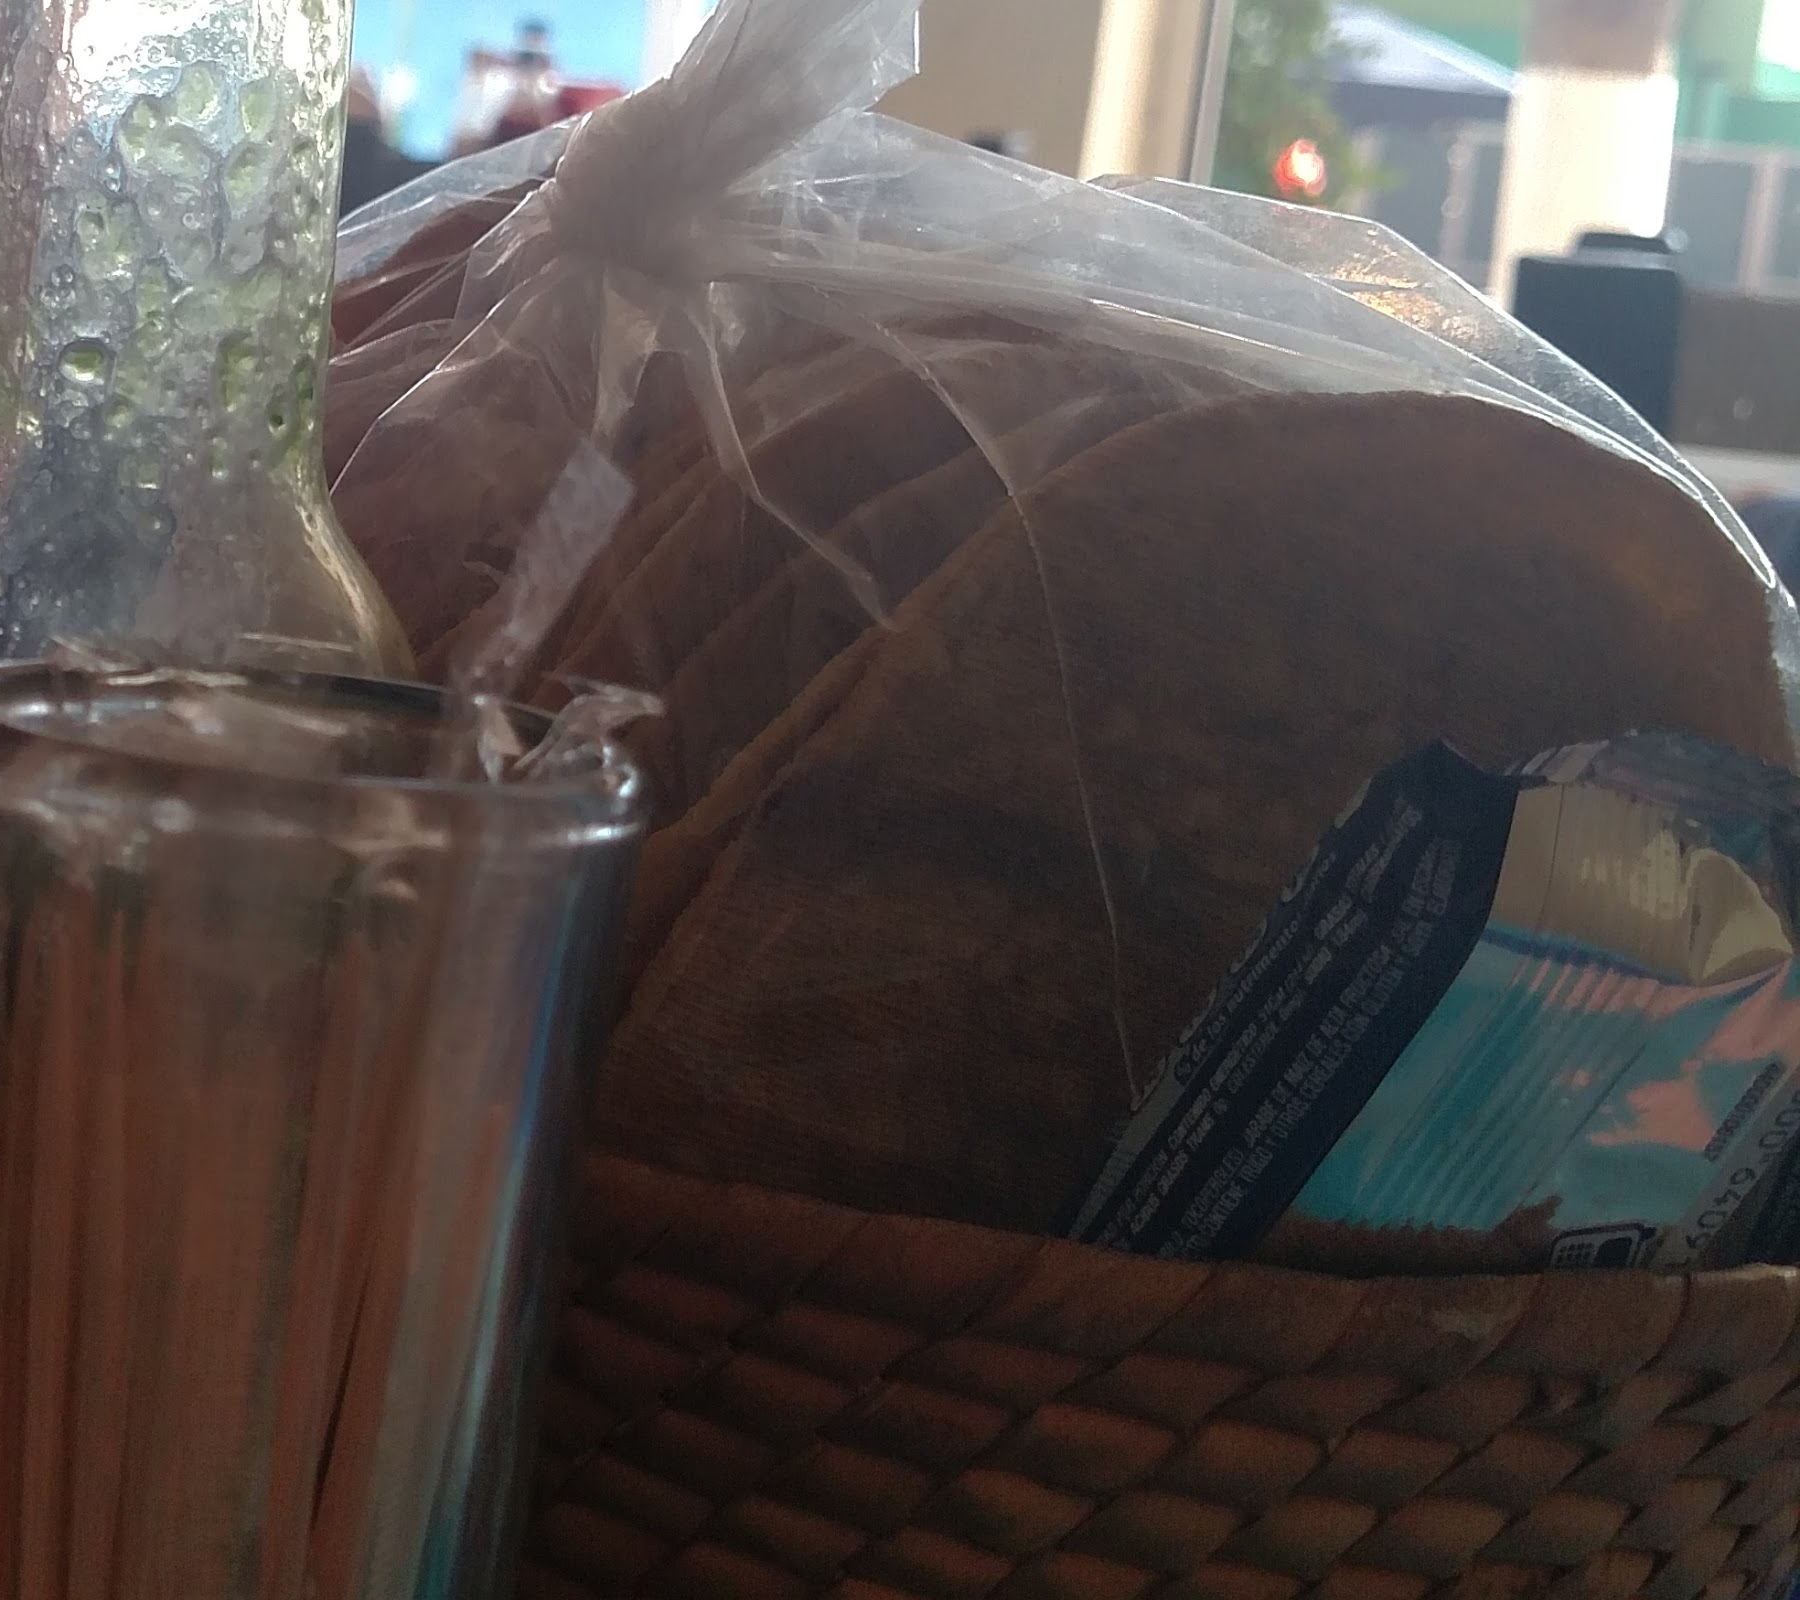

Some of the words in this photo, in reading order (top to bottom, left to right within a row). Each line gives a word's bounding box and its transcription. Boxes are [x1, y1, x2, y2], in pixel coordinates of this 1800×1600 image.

[1236, 1143, 1274, 1186] TRIGO
[1270, 1094, 1311, 1142] OTROS
[1297, 1035, 1353, 1103] CEREALES
[1339, 1008, 1373, 1045] CON
